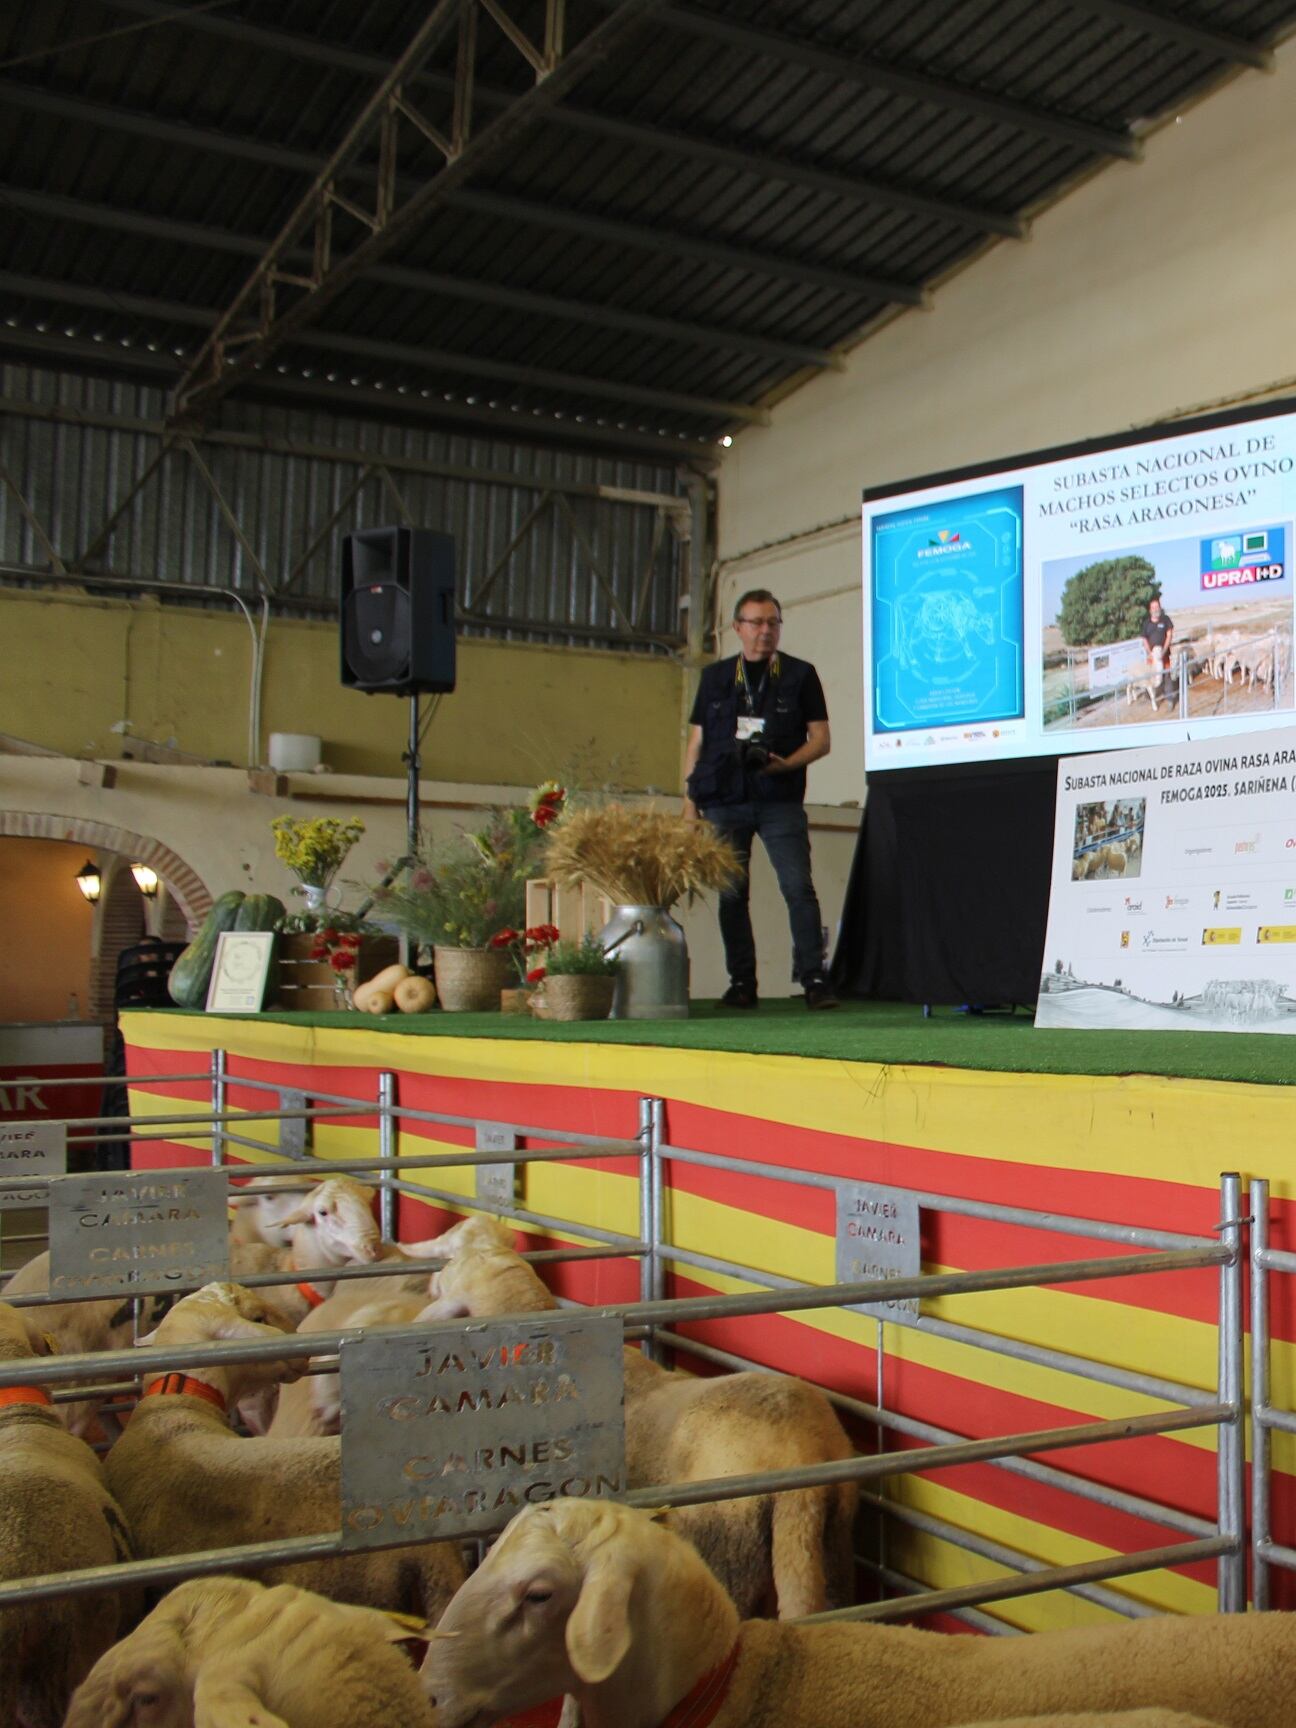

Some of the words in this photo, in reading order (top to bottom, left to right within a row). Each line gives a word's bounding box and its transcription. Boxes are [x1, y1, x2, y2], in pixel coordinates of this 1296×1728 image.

[1053, 464, 1131, 492] SUBASTA
[1136, 443, 1240, 476] NACIONAL
[1246, 435, 1275, 455] DE
[1038, 490, 1116, 518] MACHOS
[1120, 471, 1218, 503] SELECTOS
[1224, 457, 1294, 483] OVINO
[917, 541, 971, 559] FEMOGA
[1203, 567, 1254, 589] UPRA
[1256, 564, 1283, 581] I+D
[1064, 770, 1107, 791] SUBASTA
[1109, 767, 1158, 786] NACIONAL
[1160, 765, 1173, 780] DE
[1175, 762, 1202, 777] RAZA
[1205, 758, 1238, 774] OVINA
[1240, 753, 1270, 769] RASA
[1160, 786, 1202, 805] FEMOGA
[1204, 783, 1231, 799] 2025.
[1234, 776, 1288, 797] SARIÑENA
[855, 1199, 897, 1219] JAVIER
[847, 1222, 904, 1245] CAMARA
[416, 1341, 557, 1378] JAVIER
[385, 1377, 579, 1421] CAMARA
[403, 1438, 574, 1481] CARNES
[347, 1472, 622, 1530] OVIARAGON
